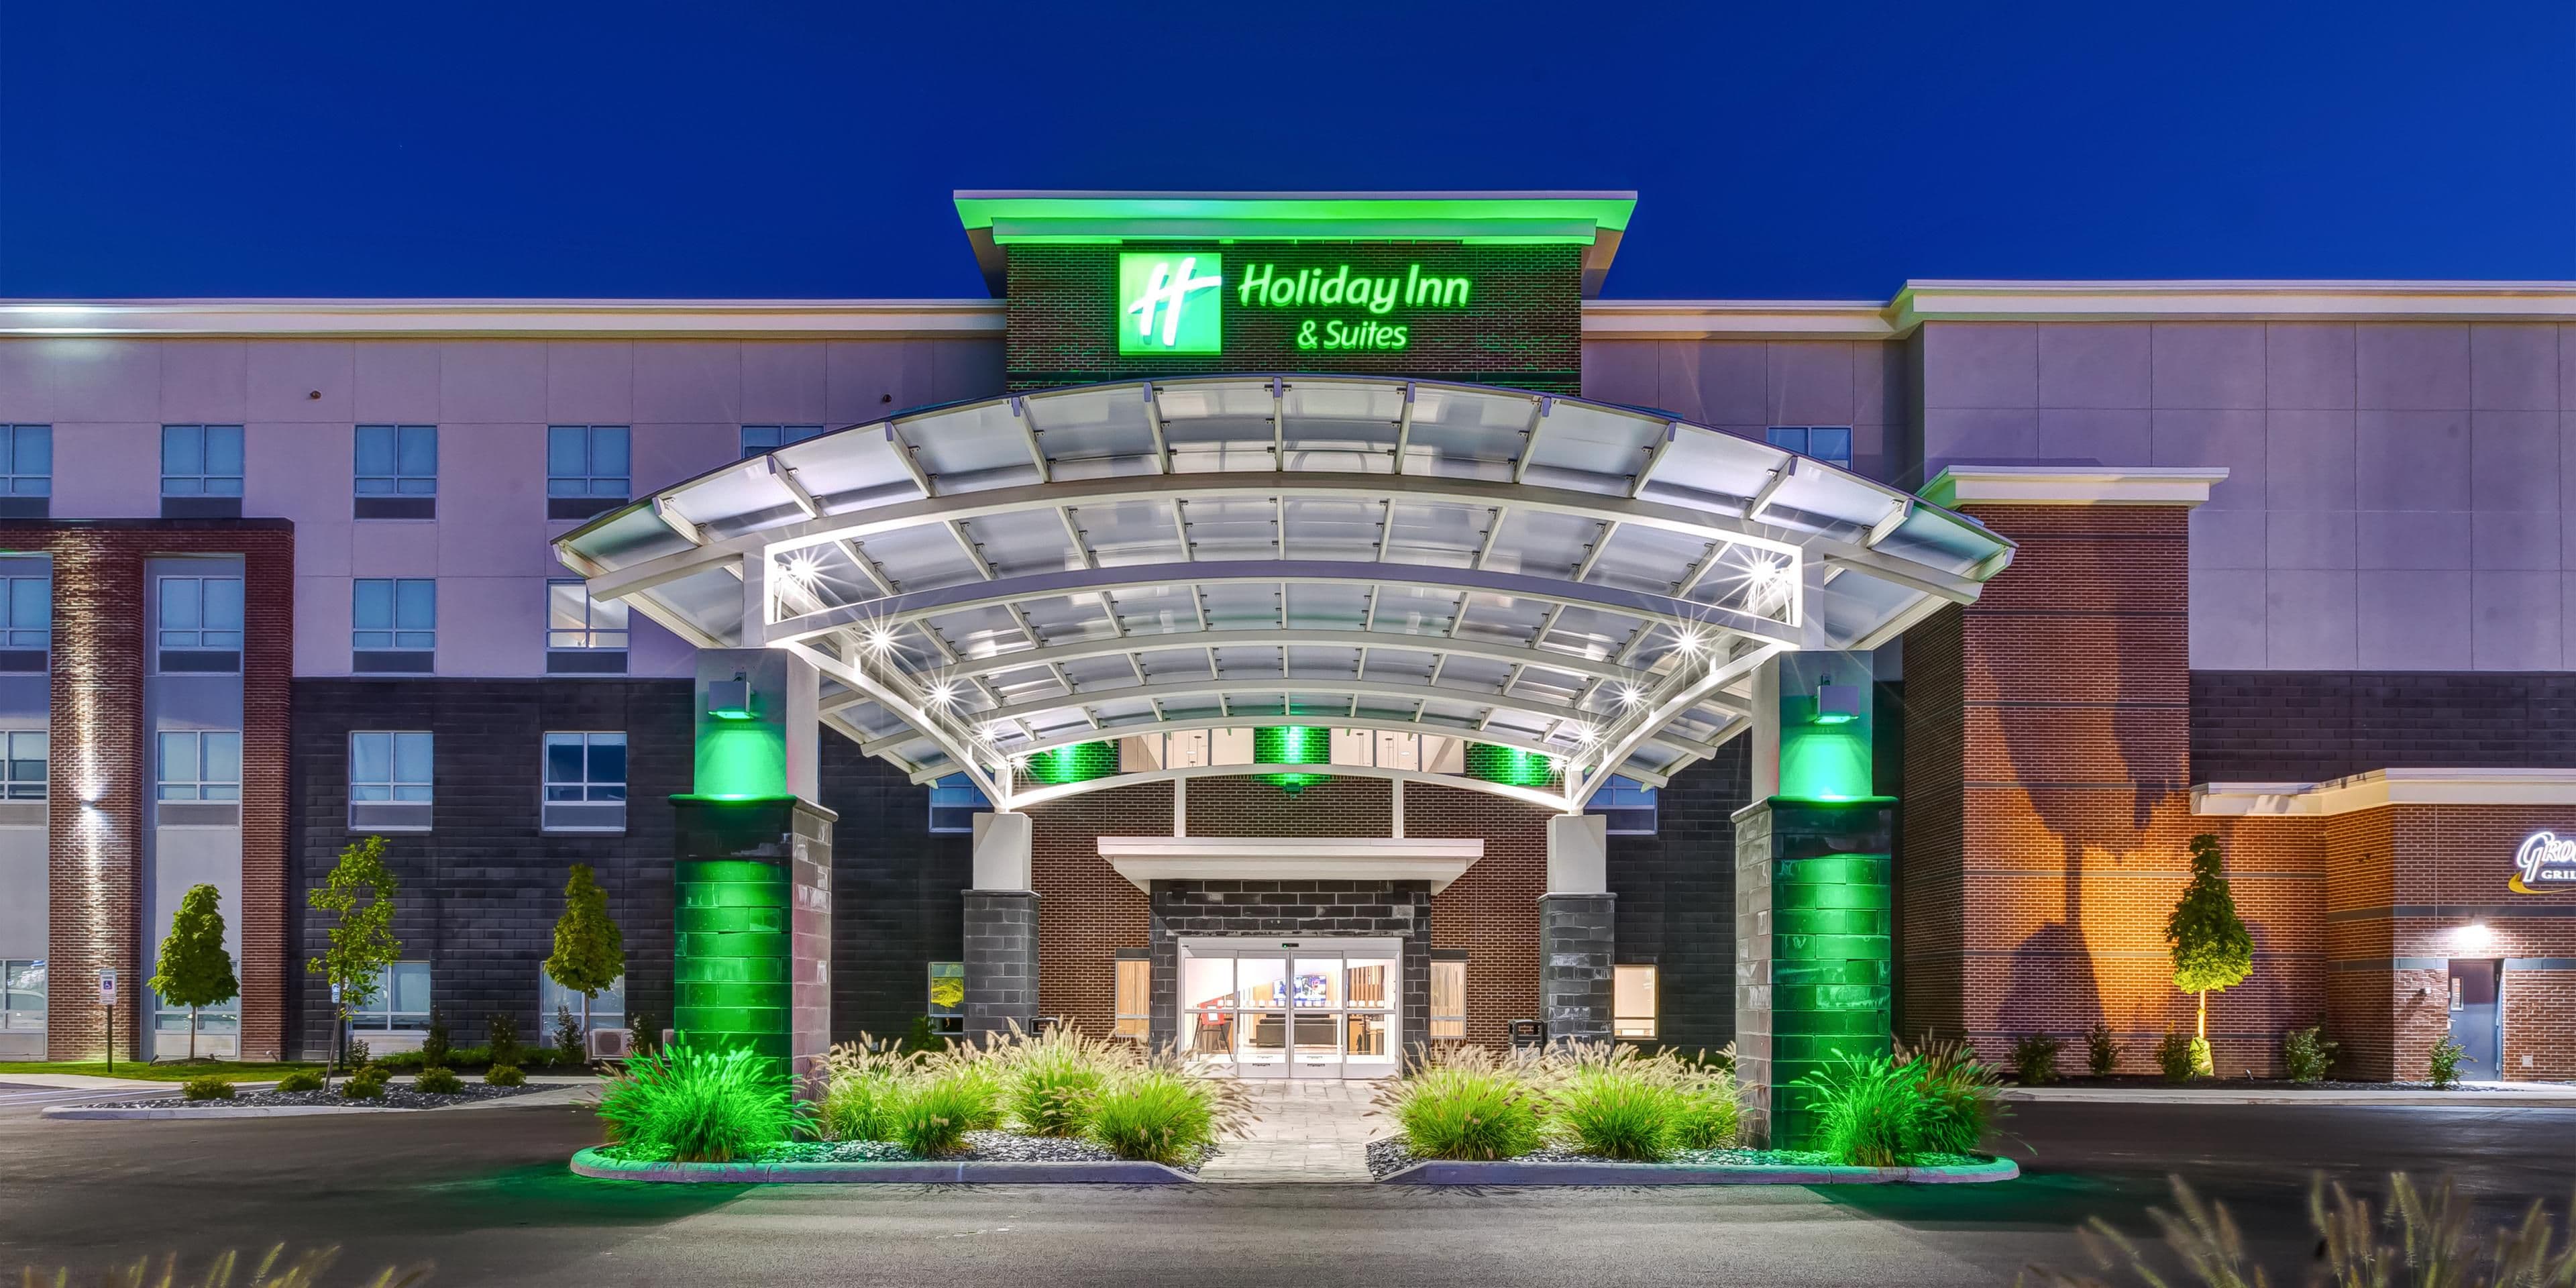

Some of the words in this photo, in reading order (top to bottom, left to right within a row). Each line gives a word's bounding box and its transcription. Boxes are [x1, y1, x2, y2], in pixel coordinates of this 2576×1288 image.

[1129, 257, 1222, 345] H
[1238, 264, 1399, 314] Holiday
[1405, 264, 1470, 307] Inn
[1297, 319, 1318, 349] &
[1323, 320, 1407, 349] Suites
